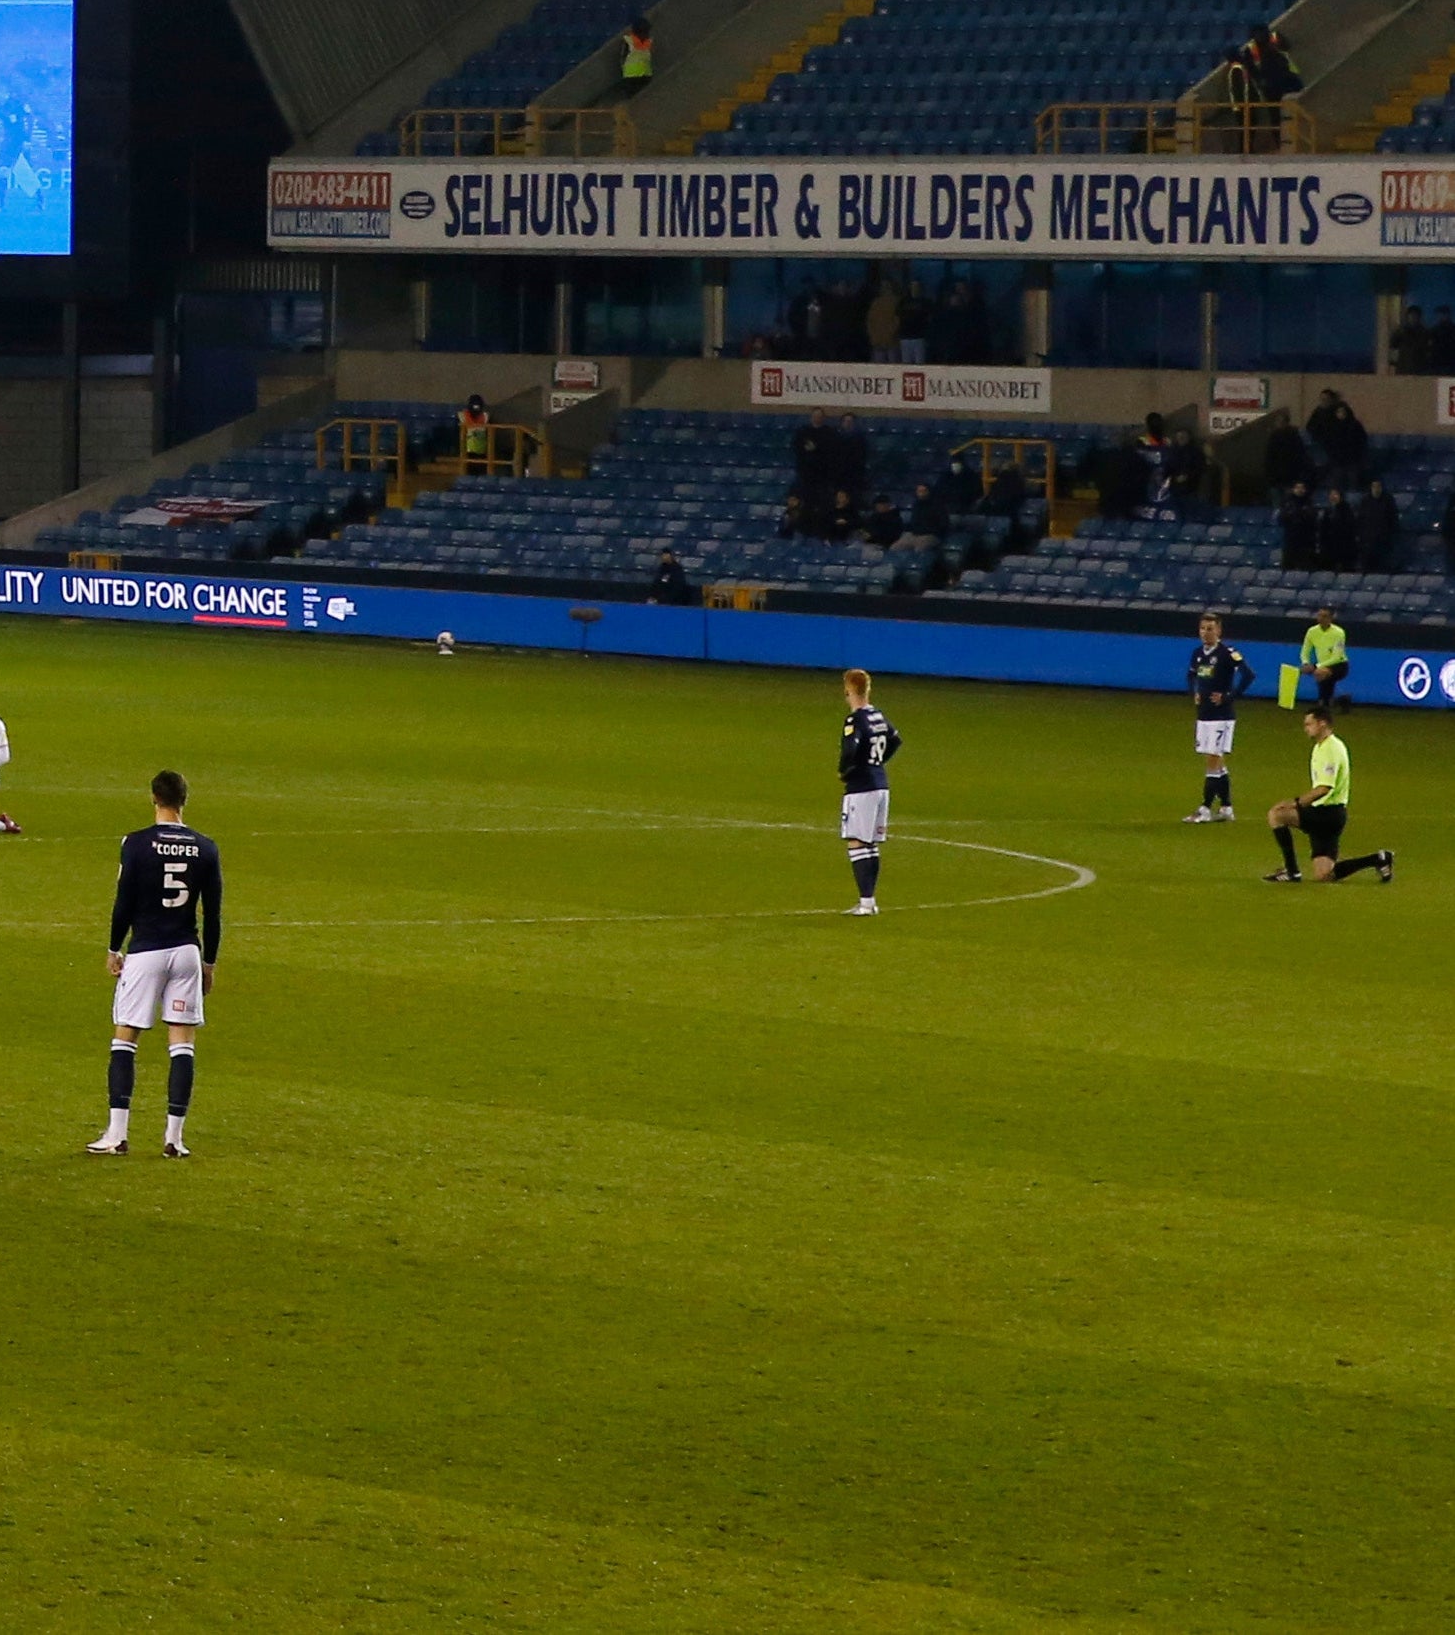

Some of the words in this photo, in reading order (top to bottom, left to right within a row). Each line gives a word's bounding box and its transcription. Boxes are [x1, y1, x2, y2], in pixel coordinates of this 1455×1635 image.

[443, 173, 624, 239] SELHURST
[633, 174, 780, 239] TIMBER
[793, 174, 823, 240] &
[839, 174, 1035, 242] BUILDERS
[1049, 174, 1320, 246] MERCHANTS
[784, 374, 895, 396] MANSIONBET
[928, 377, 1041, 400] MANSIONBET
[61, 575, 140, 608] UNITED
[145, 580, 188, 610] FOR
[192, 583, 287, 617] CHANGE
[156, 843, 199, 857] COOPER
[162, 862, 190, 907] 5
